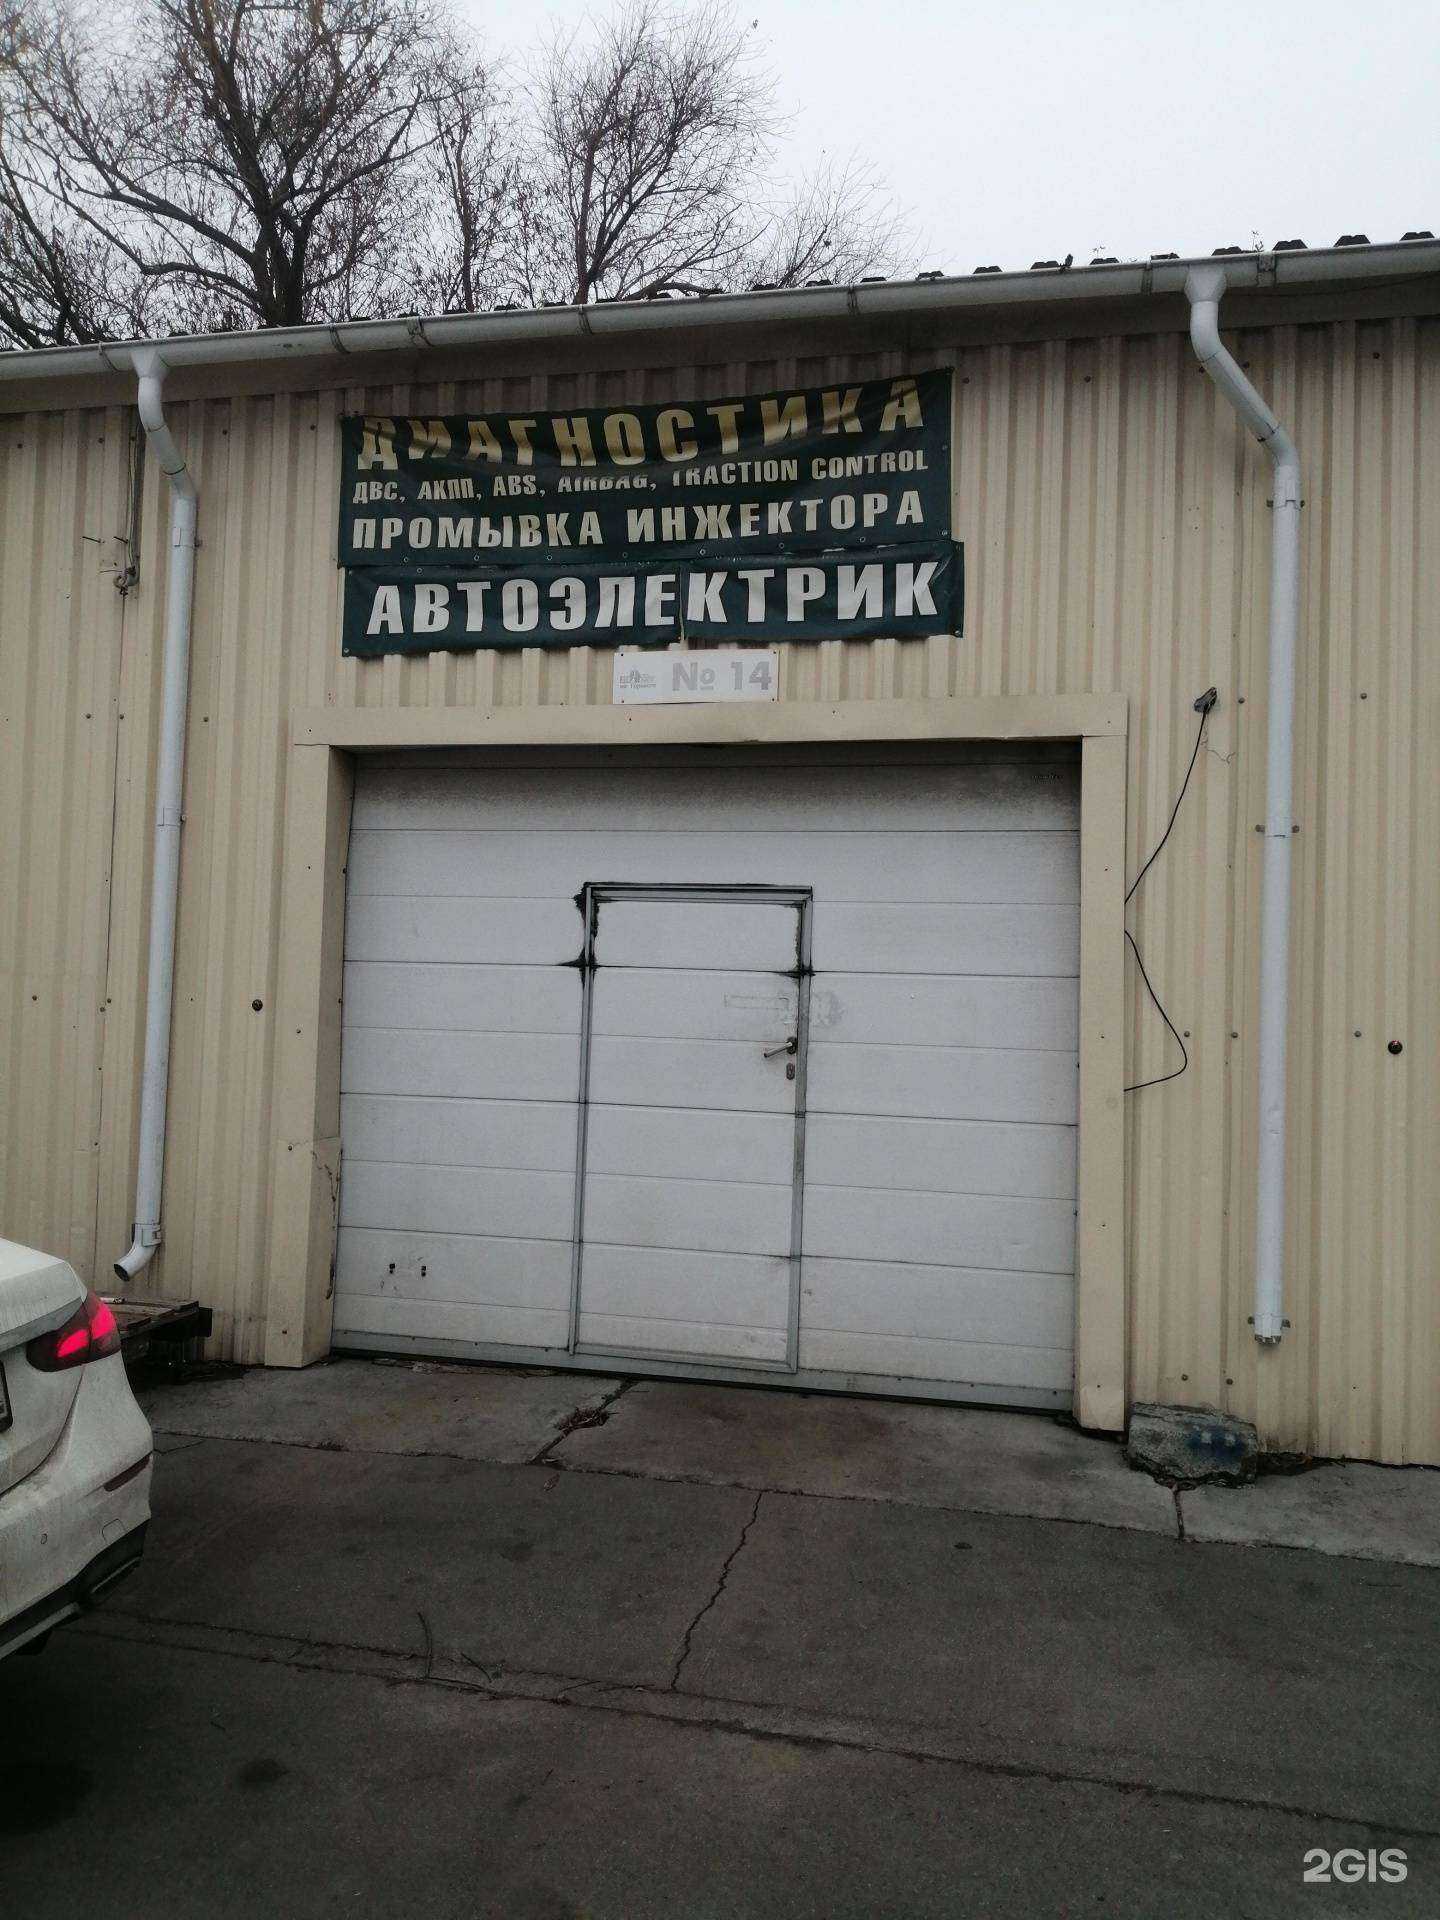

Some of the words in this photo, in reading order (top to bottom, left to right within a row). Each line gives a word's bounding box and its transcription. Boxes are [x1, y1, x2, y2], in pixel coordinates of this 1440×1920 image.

[357, 380, 924, 470] ДИАГНОСТИКА
[352, 481, 406, 504] ДВС,
[417, 478, 482, 501] АКПП,
[811, 450, 929, 480] CONTROL
[352, 511, 603, 549] ПРОМЫВКА
[627, 490, 924, 543] ИНЖЕКТОРА
[366, 561, 939, 635] АВТОЭЛЕКТРИК
[731, 661, 772, 690] 14
